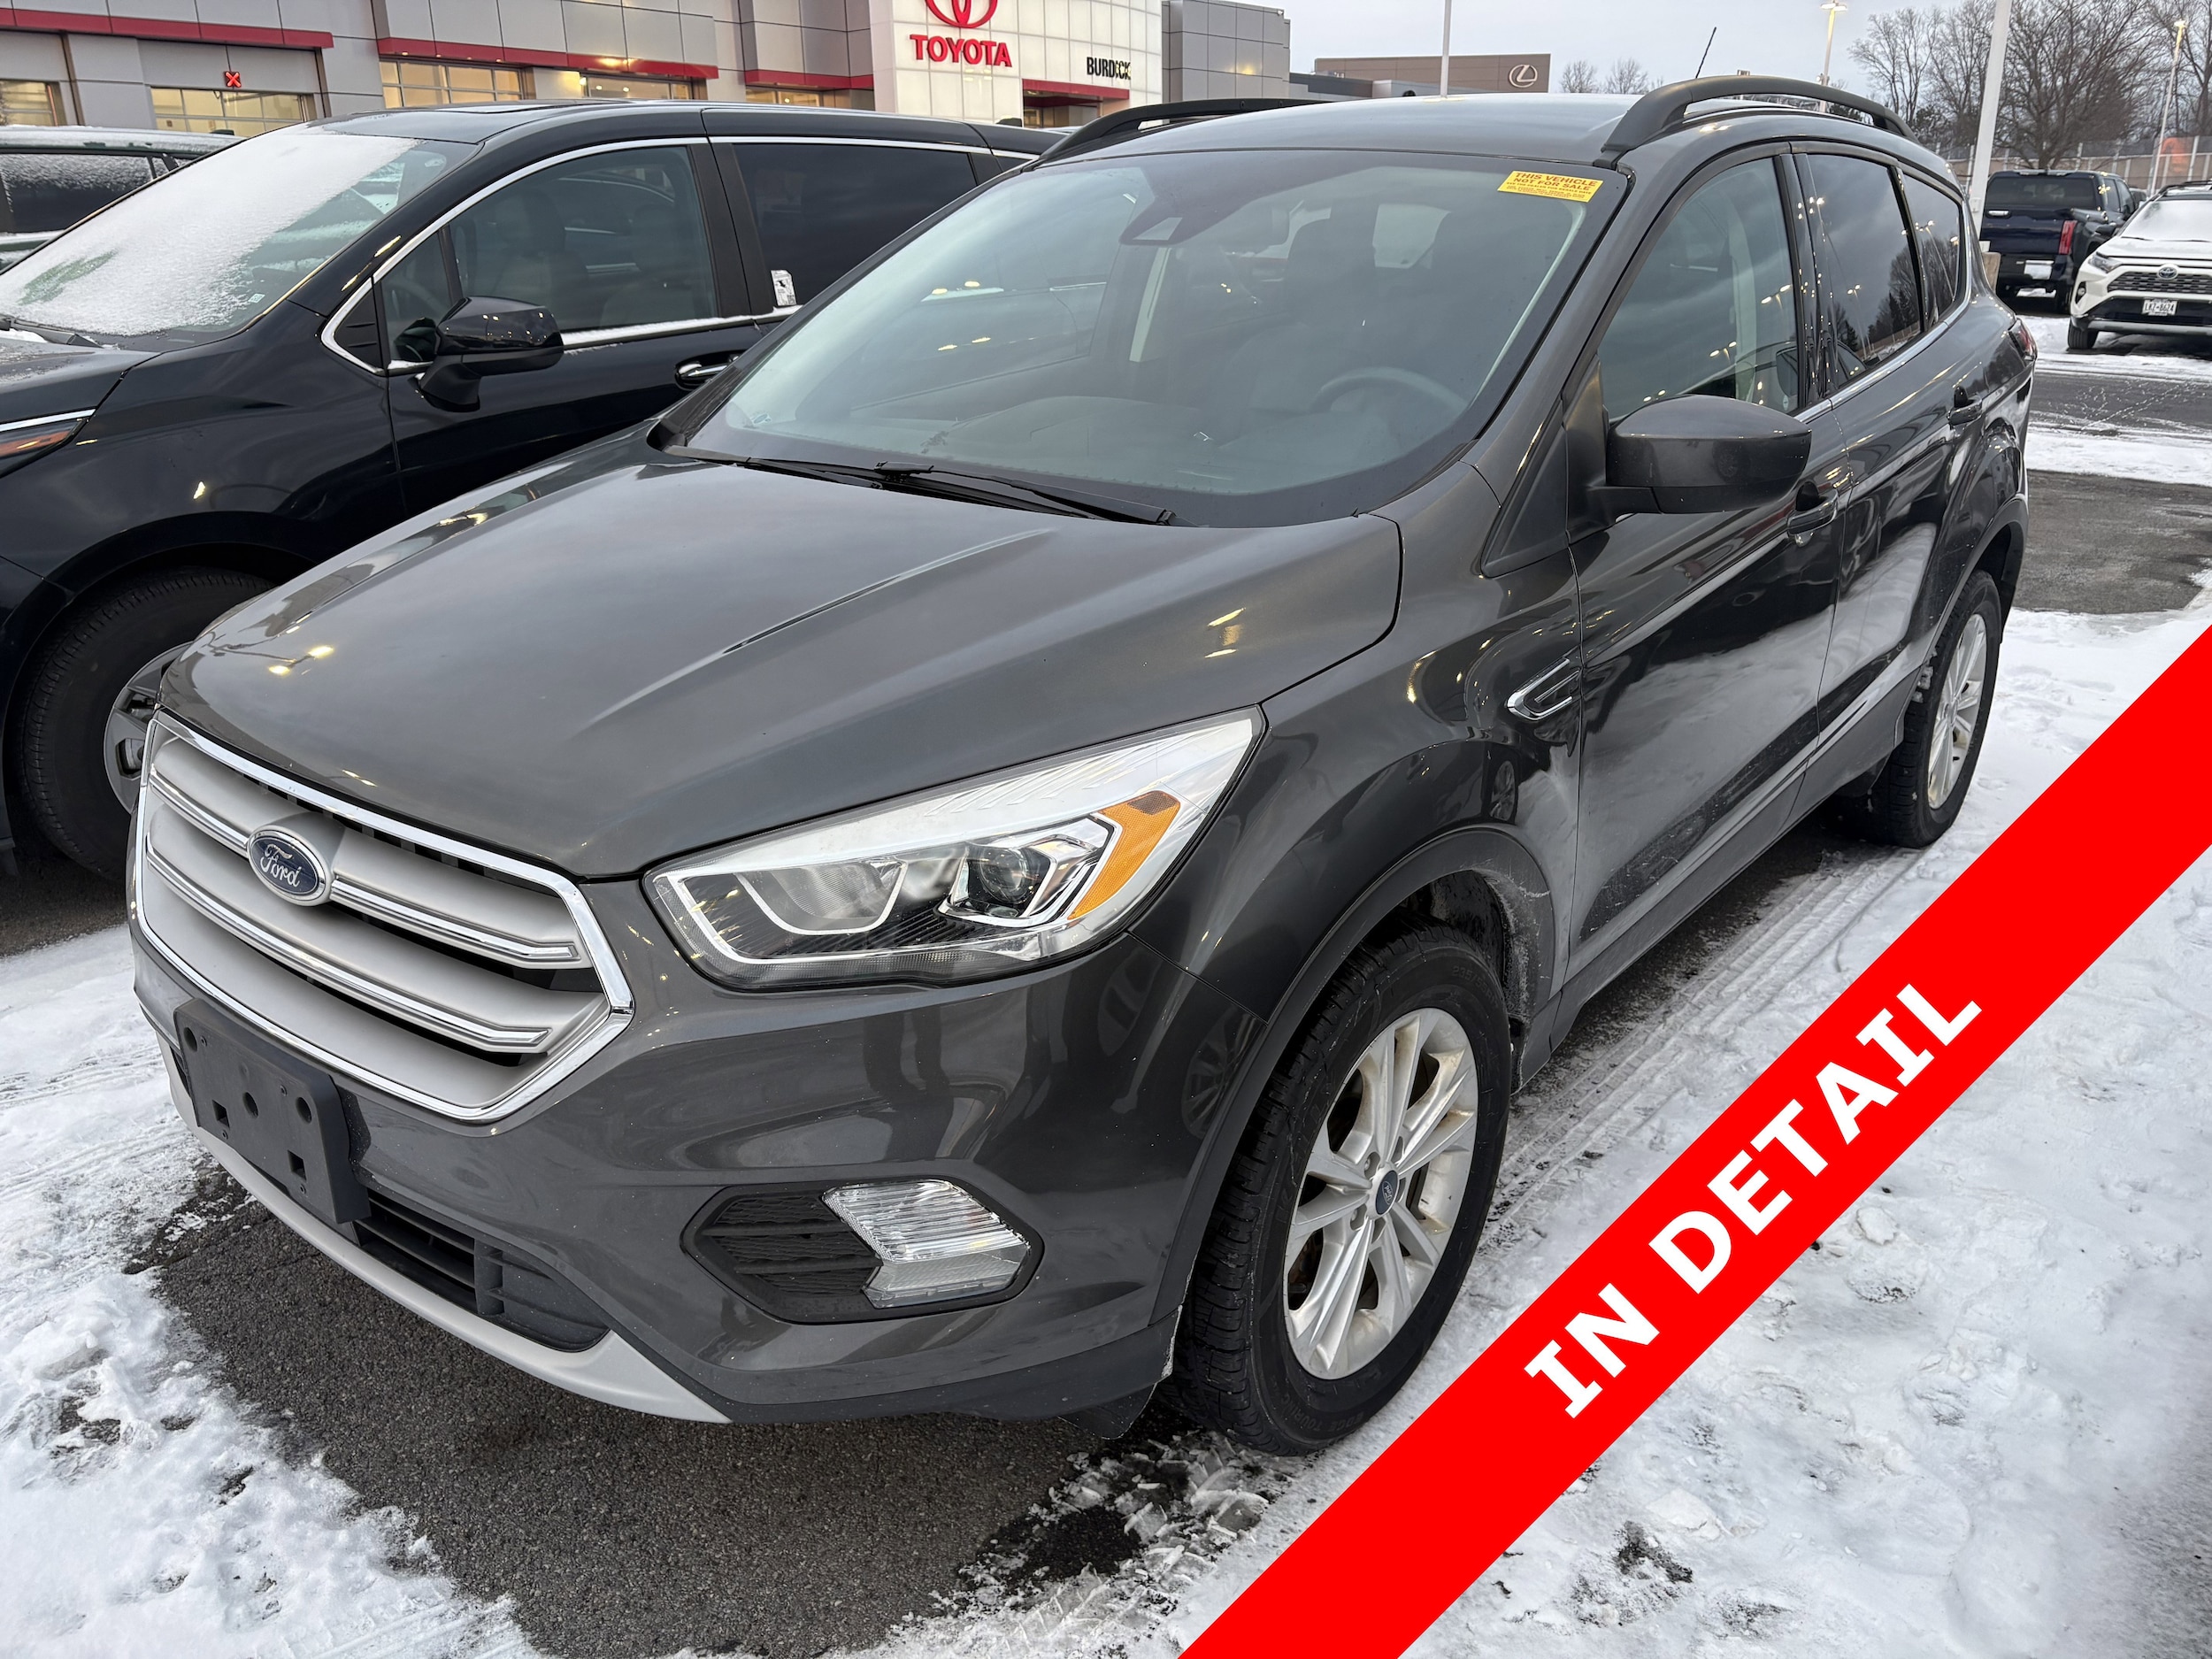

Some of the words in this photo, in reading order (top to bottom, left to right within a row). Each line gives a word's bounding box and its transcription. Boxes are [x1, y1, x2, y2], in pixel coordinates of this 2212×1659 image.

[910, 34, 1012, 67] TOYOTA
[1546, 175, 1598, 187] VEHICLE
[260, 843, 303, 887] Ford
